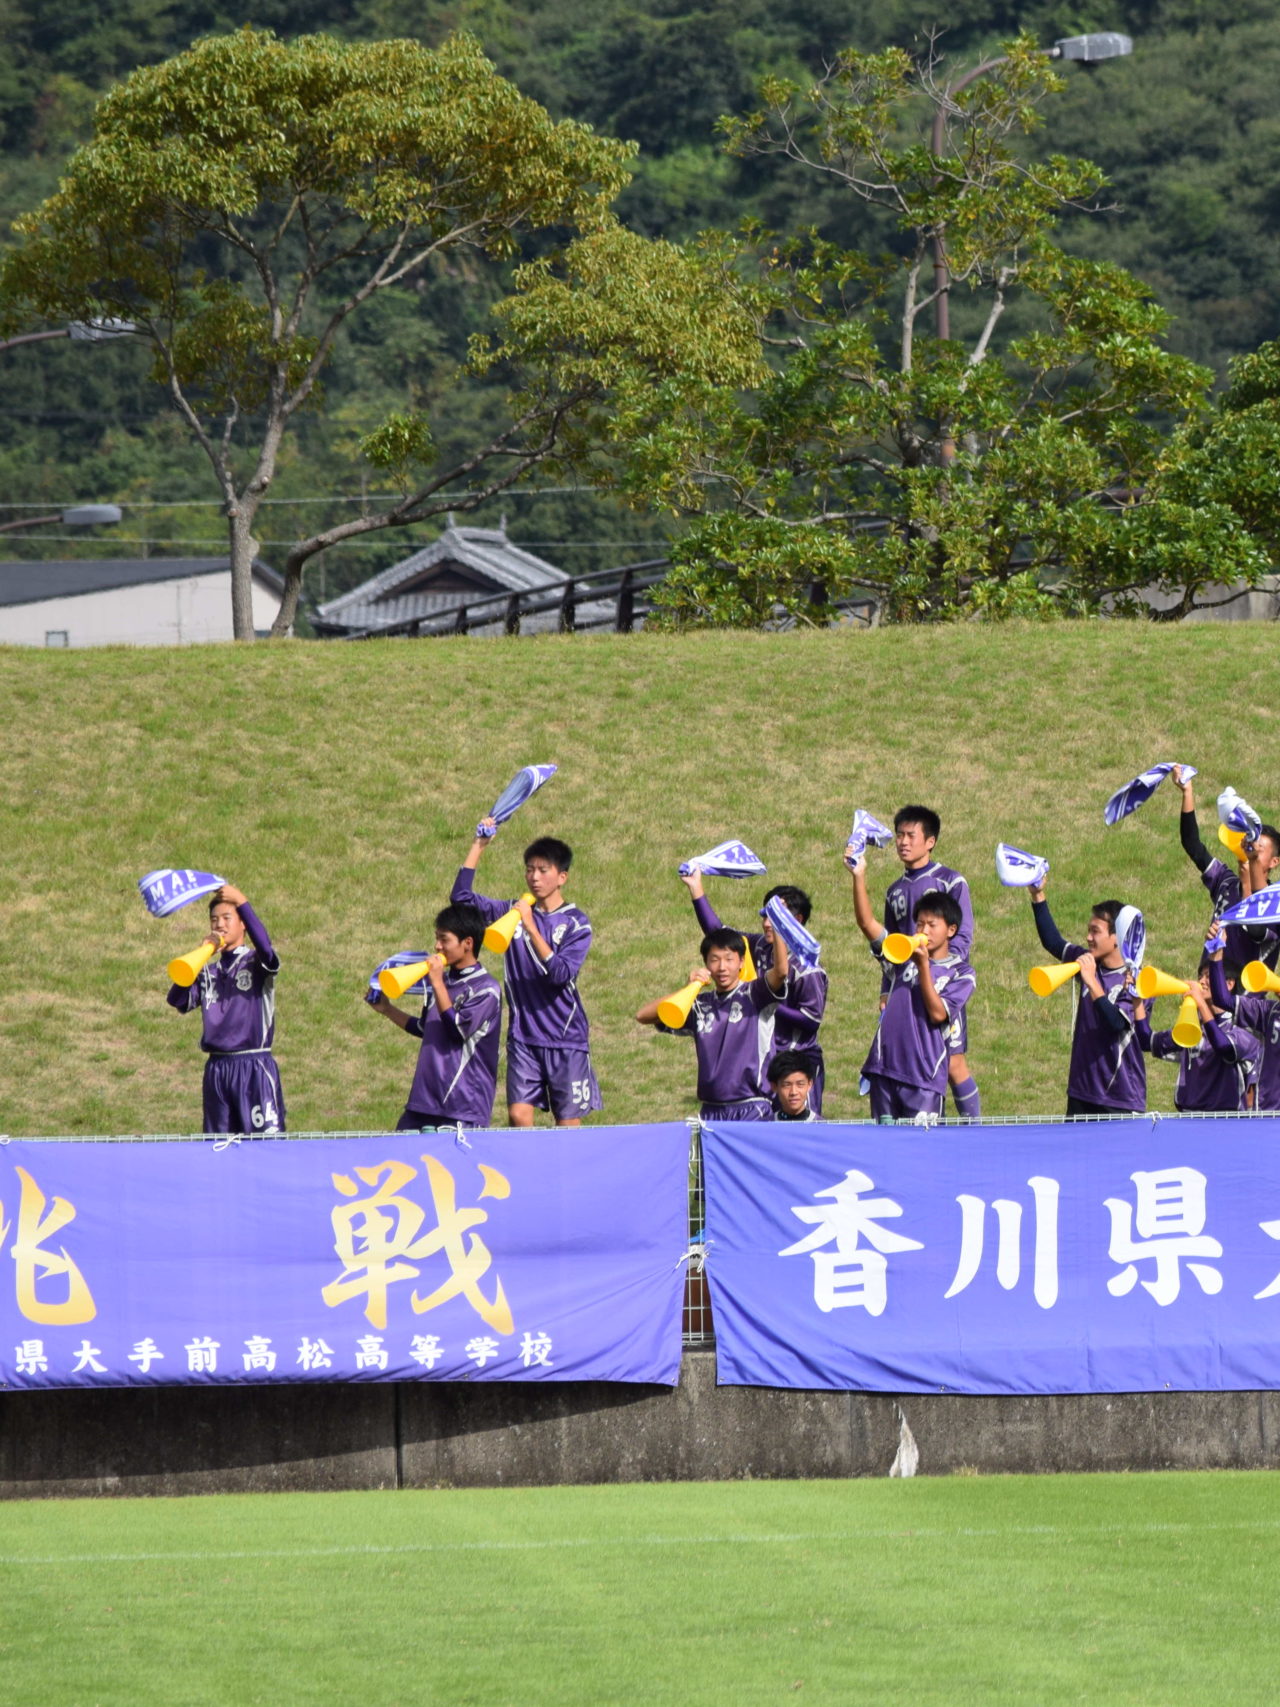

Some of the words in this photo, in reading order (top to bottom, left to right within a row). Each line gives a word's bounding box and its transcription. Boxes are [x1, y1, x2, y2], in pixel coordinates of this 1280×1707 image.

[892, 897, 907, 920] 29
[571, 1078, 590, 1104] 56
[251, 1101, 278, 1128] 64
[15, 1332, 554, 1375] 県大手前高松高等学校
